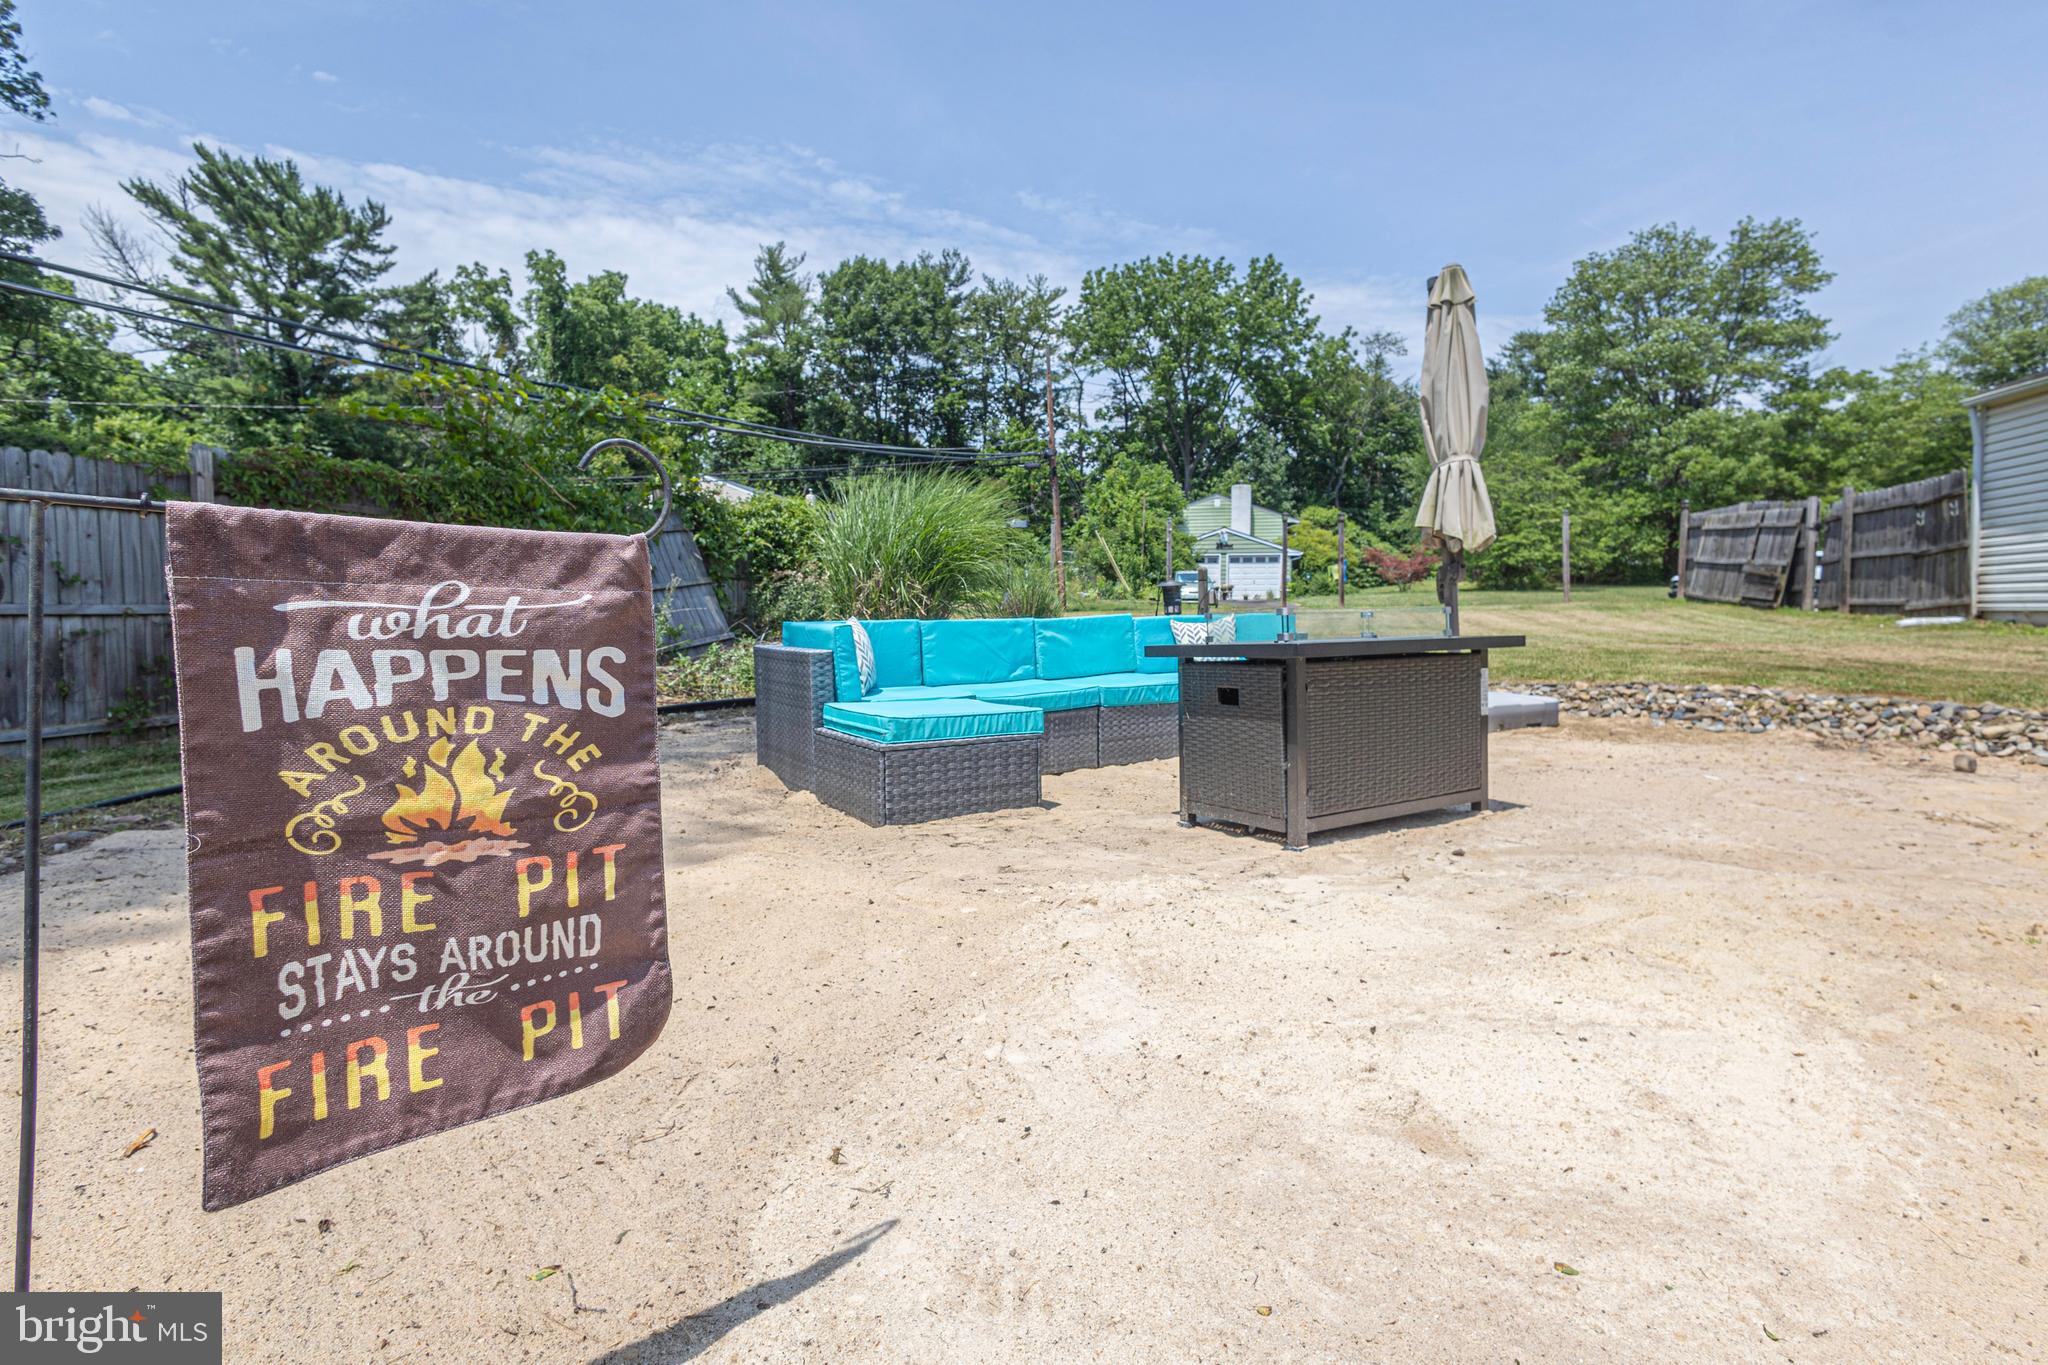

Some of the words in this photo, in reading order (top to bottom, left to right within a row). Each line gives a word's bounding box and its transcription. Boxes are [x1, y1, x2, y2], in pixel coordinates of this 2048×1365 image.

[274, 581, 593, 640] what
[234, 646, 627, 732] HAPPENS
[279, 706, 495, 797] AROUND
[521, 713, 602, 772] THE
[248, 871, 436, 957] FIRE
[517, 843, 626, 917] PIT
[278, 943, 418, 1020] STAYS
[440, 913, 602, 974] AROUND
[390, 973, 509, 1013] the
[258, 1023, 443, 1139] FIRE
[521, 981, 627, 1061] PIT
